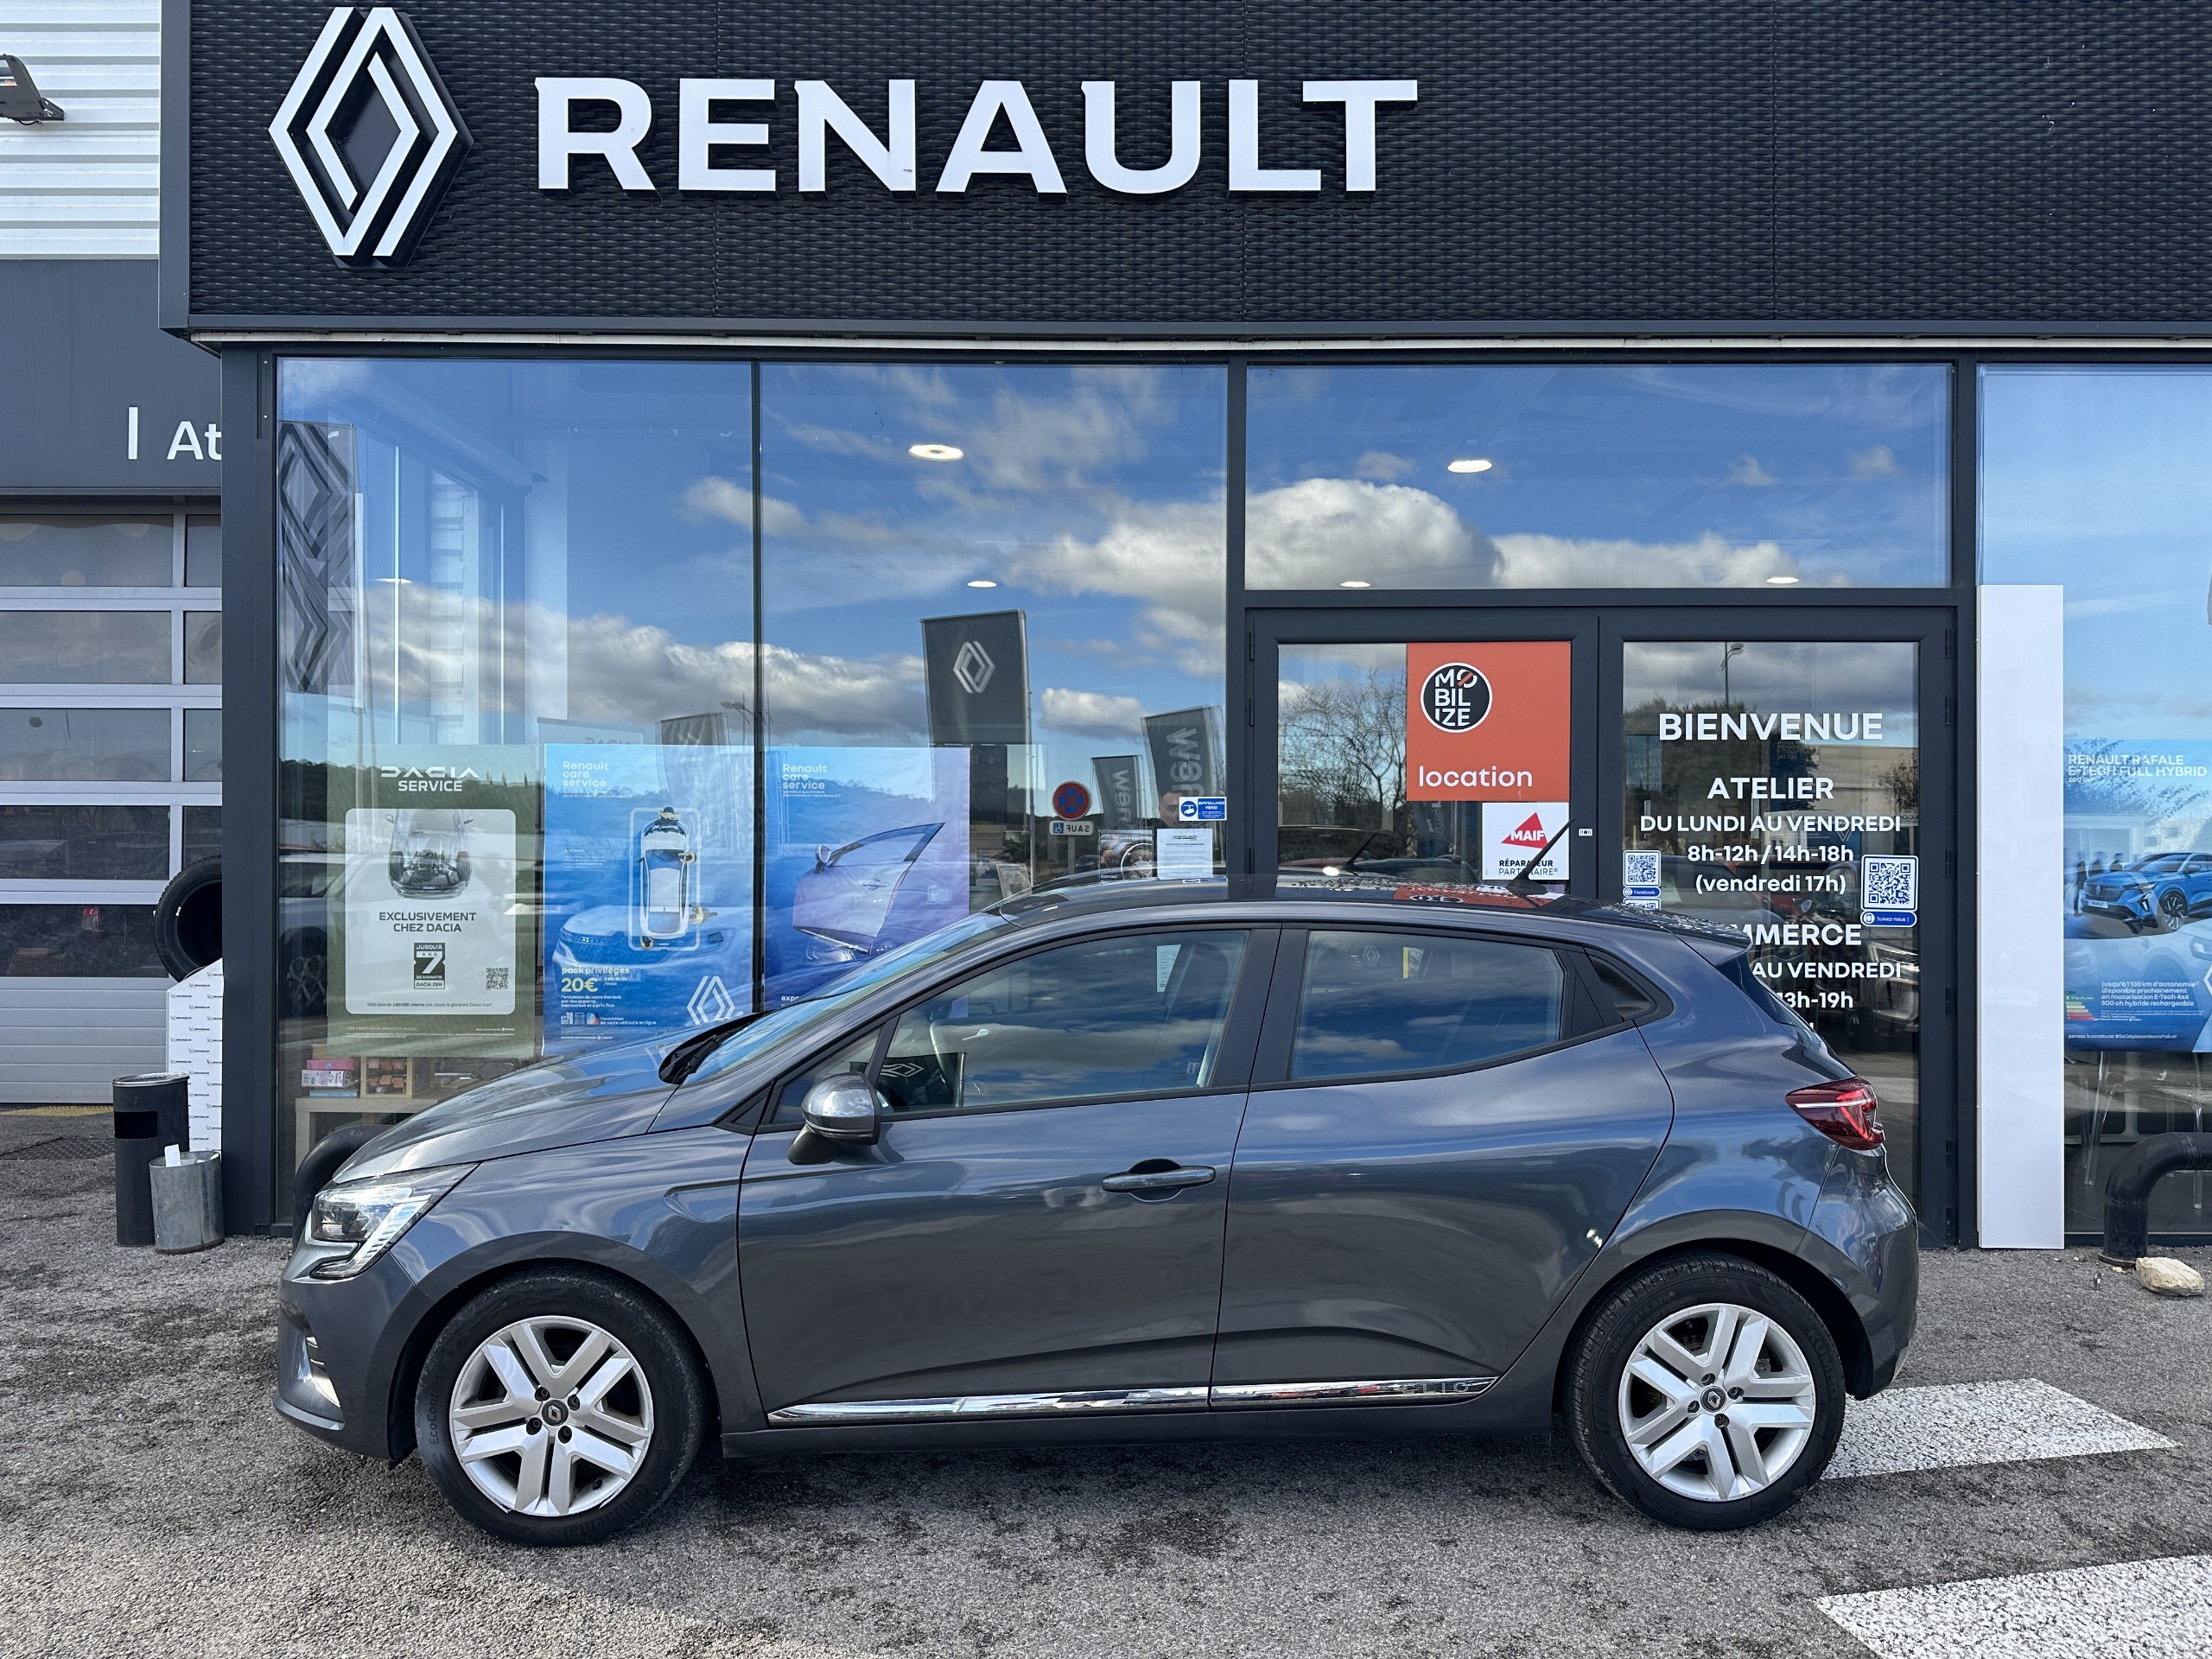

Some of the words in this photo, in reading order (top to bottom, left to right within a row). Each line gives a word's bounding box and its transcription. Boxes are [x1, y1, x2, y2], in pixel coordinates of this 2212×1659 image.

[534, 76, 1418, 194] RENAULT
[1435, 689, 1471, 707] BIL
[1435, 709, 1471, 726] IZE
[1659, 713, 1883, 741] BIENVENUE
[563, 761, 608, 770] Renault
[2069, 754, 2130, 766] RENAULT
[2133, 755, 2183, 765] RAFALE
[381, 766, 480, 778] DACIA
[783, 764, 827, 773] Renault
[2069, 766, 2117, 776] E-TECH
[2120, 766, 2152, 777] FULL
[2157, 766, 2208, 776] HYBRID
[563, 779, 607, 787] service
[1419, 766, 1532, 787] location
[398, 780, 463, 791] SERVICE
[1707, 777, 1834, 799] ATELIER
[1640, 816, 1672, 832] DU
[1678, 816, 1745, 832] LUNDI
[1750, 816, 1782, 832] AU
[1788, 816, 1901, 832] VENDREDI
[1510, 830, 1545, 842] MAIF
[1688, 845, 1758, 861] 8h-12h
[1775, 845, 1854, 861] 14h-18h
[1696, 874, 1801, 894] (vendredi
[1805, 874, 1847, 894] 17h)
[379, 912, 477, 921] EXCLUSIVEMENT
[394, 923, 423, 932] CHEZ
[426, 923, 462, 932] DACIA
[416, 951, 442, 974] 7
[586, 967, 629, 976] privilèges
[1752, 962, 1783, 979] AU
[1787, 962, 1901, 978] VENDREDI
[562, 977, 598, 992] 20€
